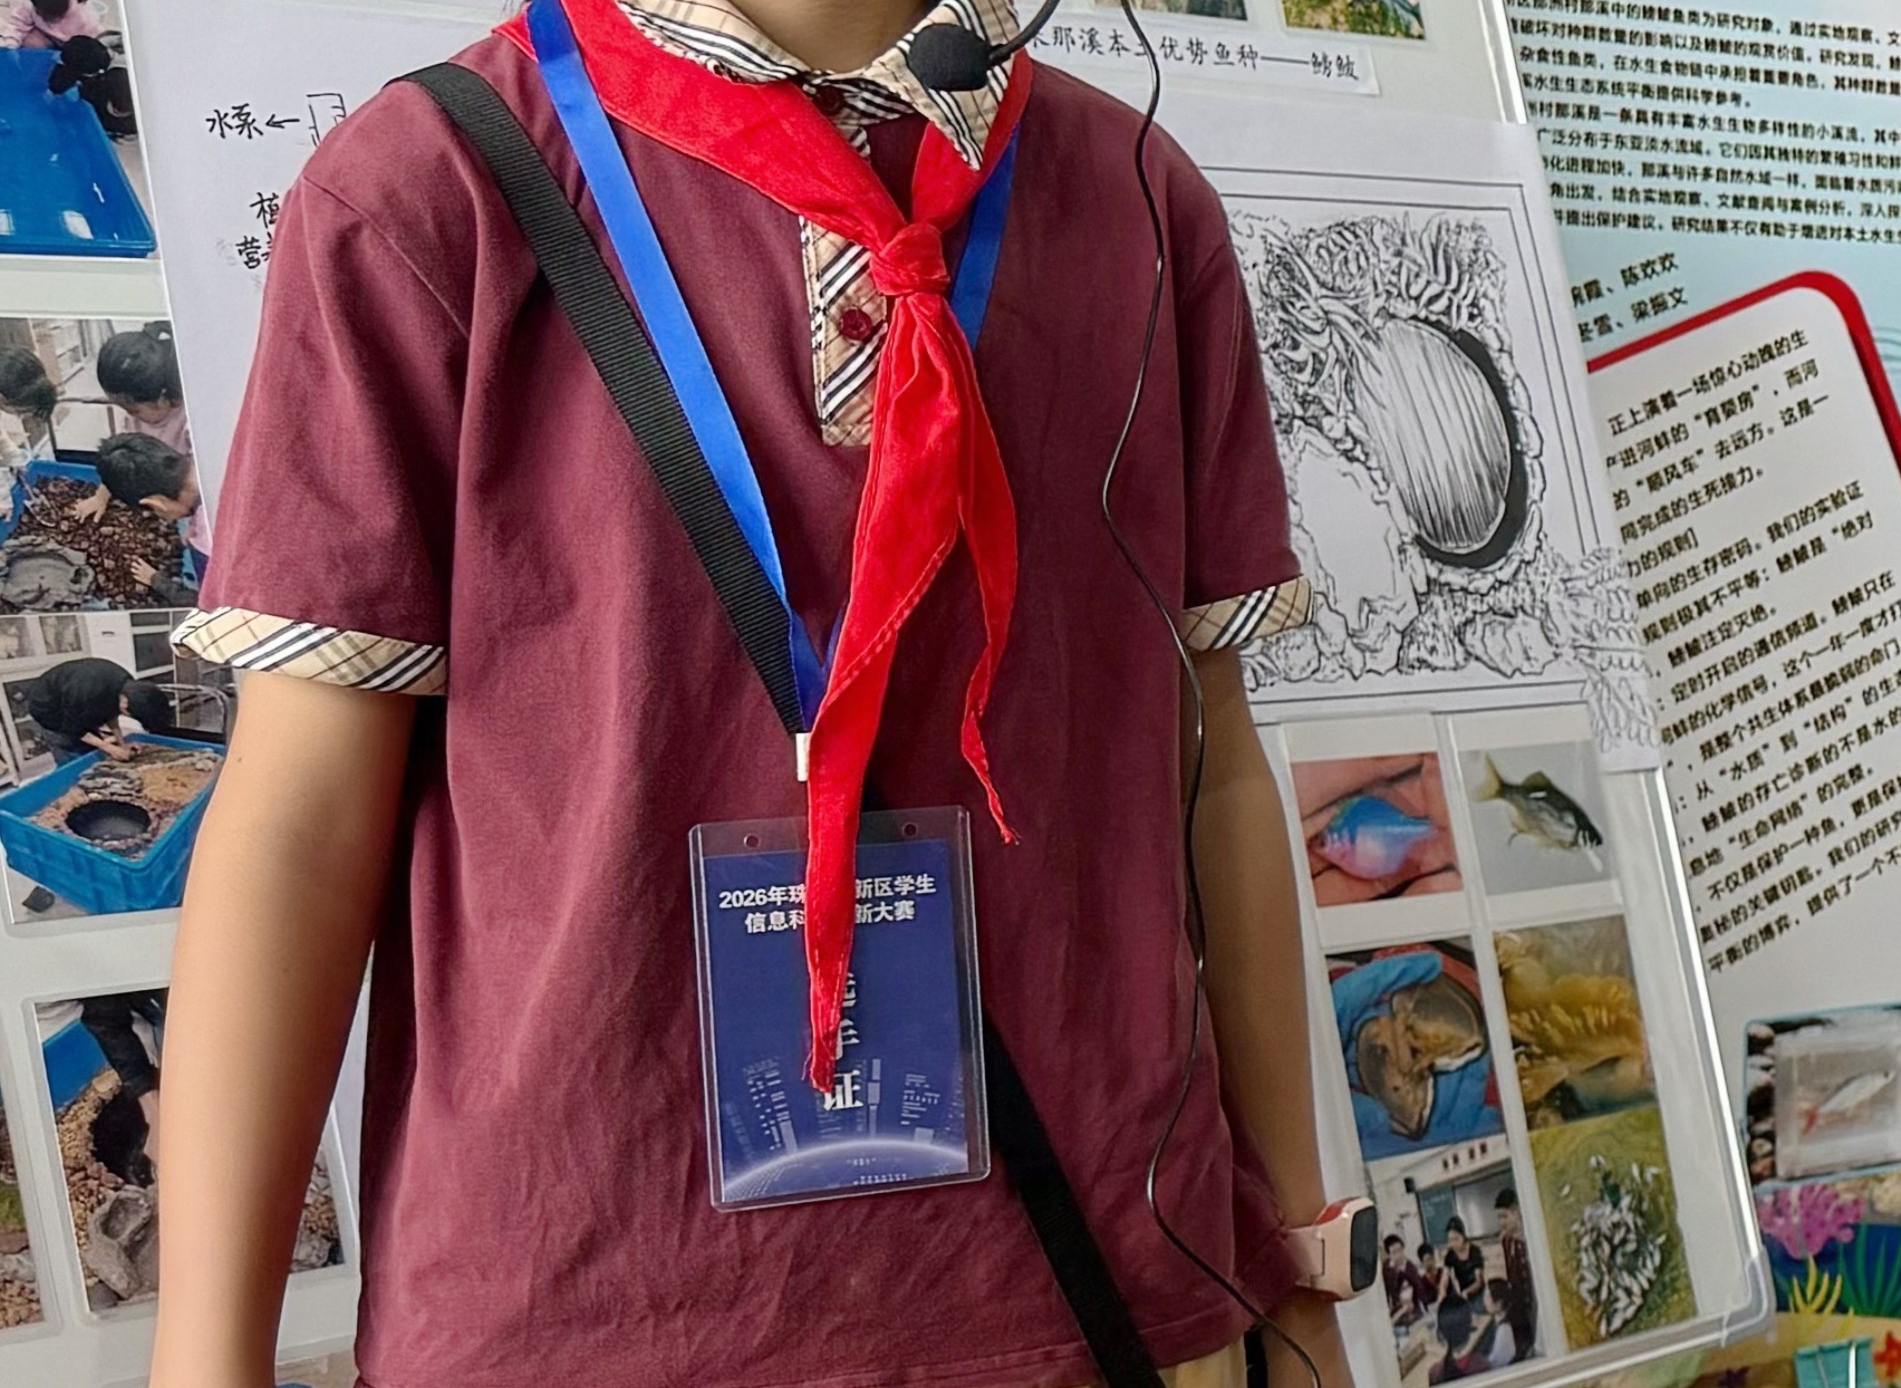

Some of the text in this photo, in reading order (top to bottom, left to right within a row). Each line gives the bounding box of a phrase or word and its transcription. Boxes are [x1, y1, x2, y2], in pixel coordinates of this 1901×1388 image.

[719, 873, 937, 910] 2026年珠新区学生
[745, 900, 915, 935] 信息科新大赛
